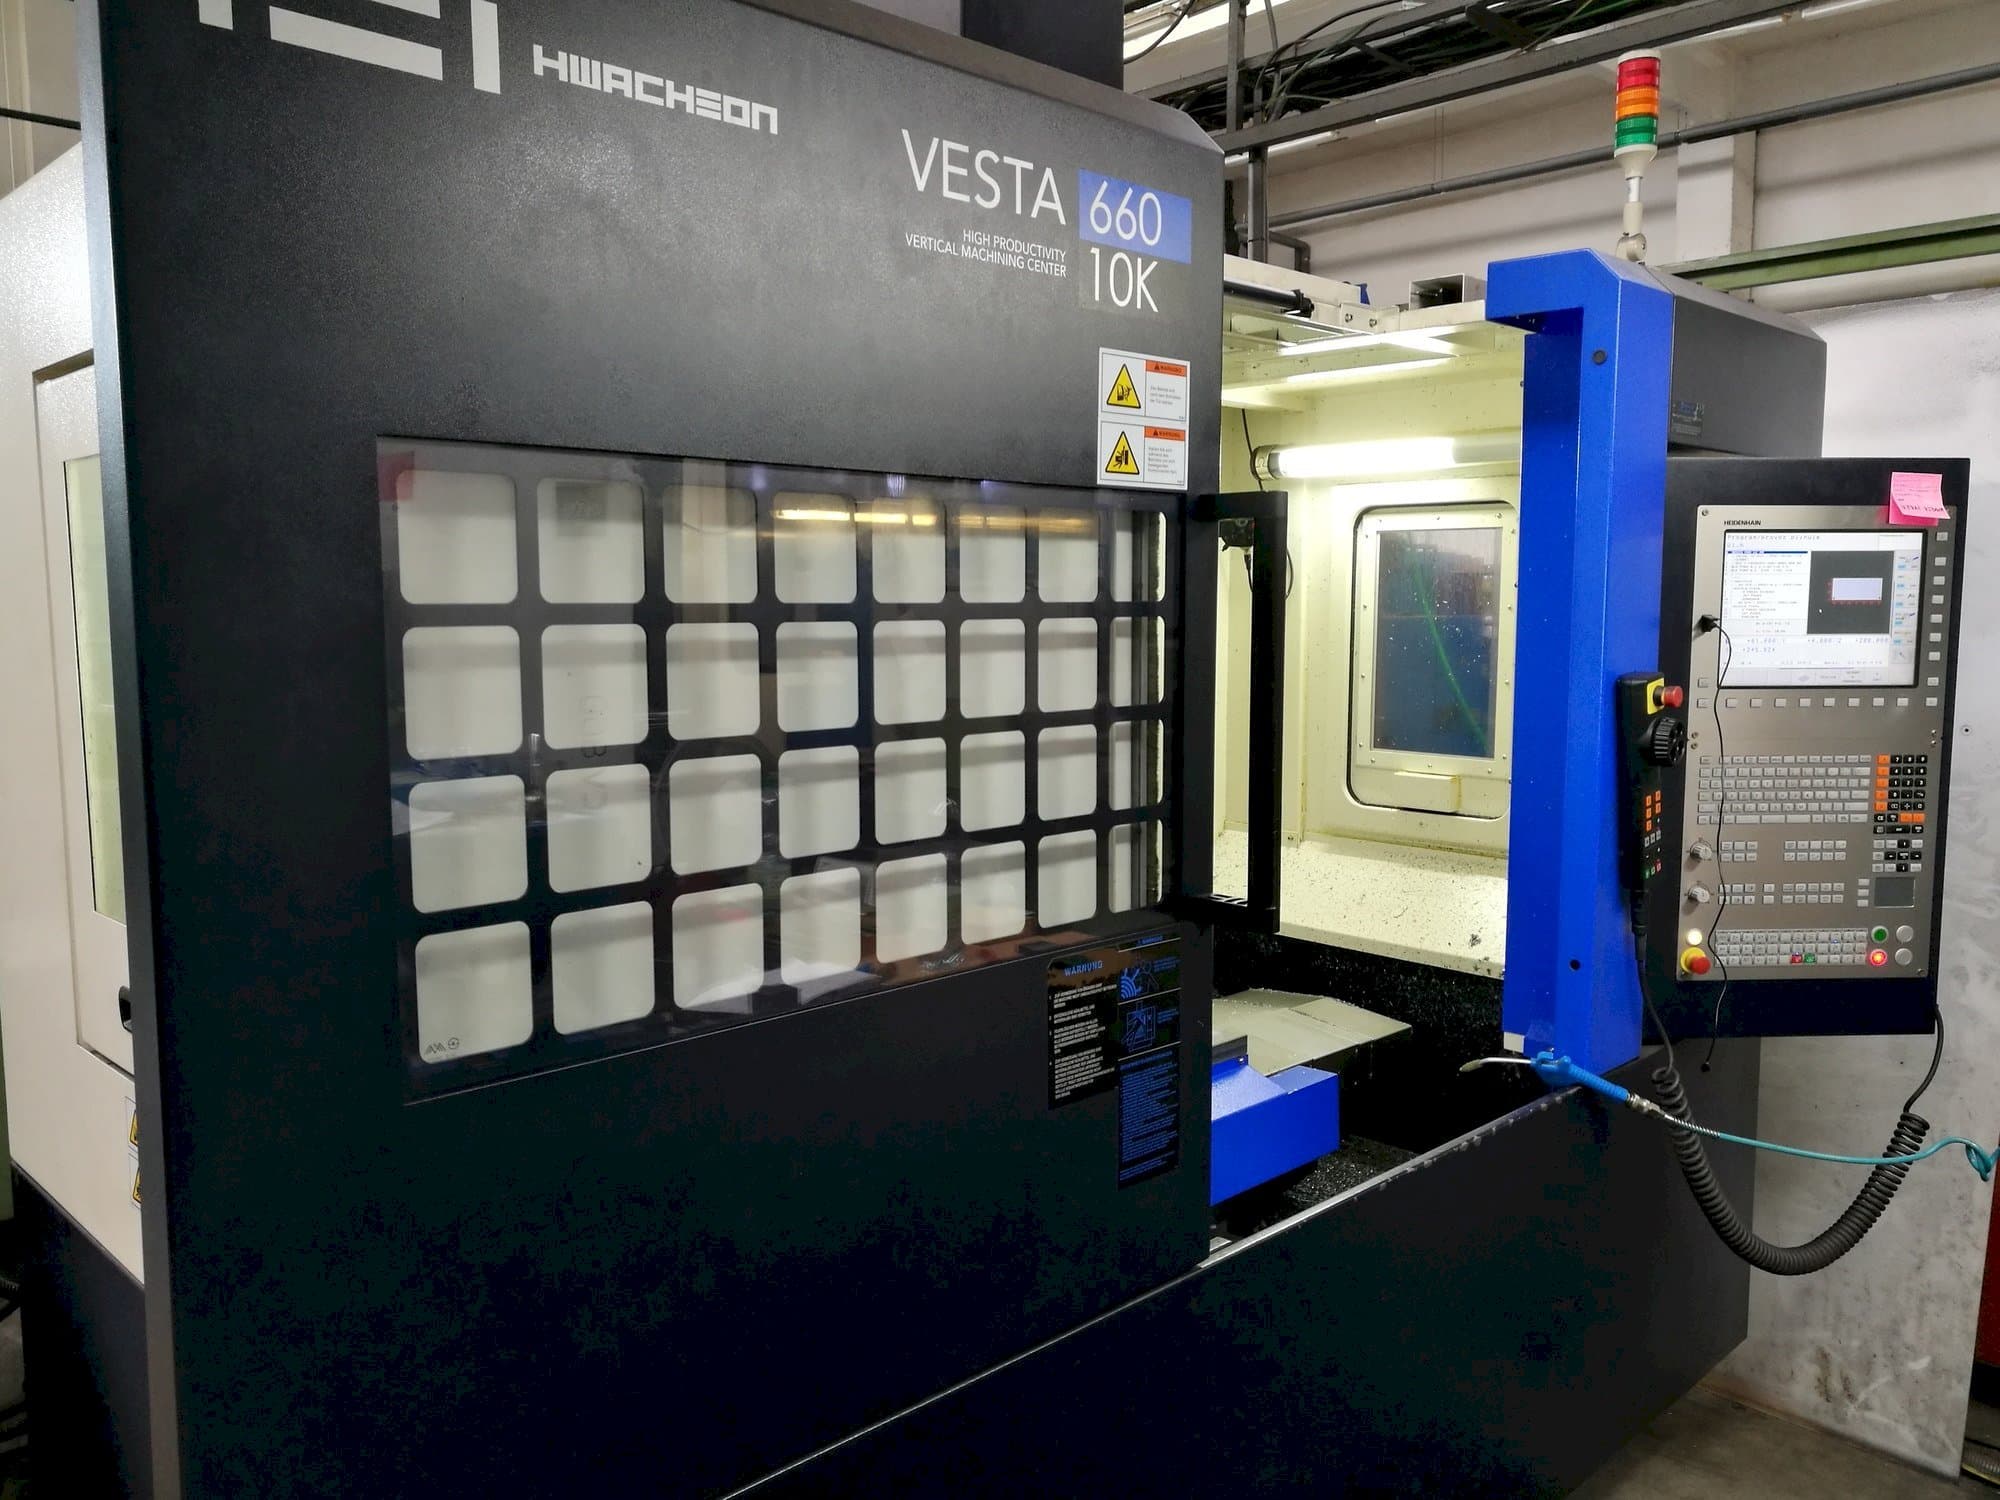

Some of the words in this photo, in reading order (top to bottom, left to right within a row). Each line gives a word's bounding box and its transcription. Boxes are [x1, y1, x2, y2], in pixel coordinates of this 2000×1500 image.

[533, 44, 778, 135] HWACHEON
[902, 129, 1066, 225] VESTA
[1090, 180, 1162, 246] 660
[905, 232, 959, 256] VERTICAL
[961, 244, 1025, 269] MACHINING
[1027, 258, 1067, 278] CENTER
[963, 229, 990, 247] HIGH
[993, 235, 1066, 262] PRODUCTIVITY
[1090, 247, 1158, 312] 10K
[1064, 960, 1103, 976] WARNUNG
